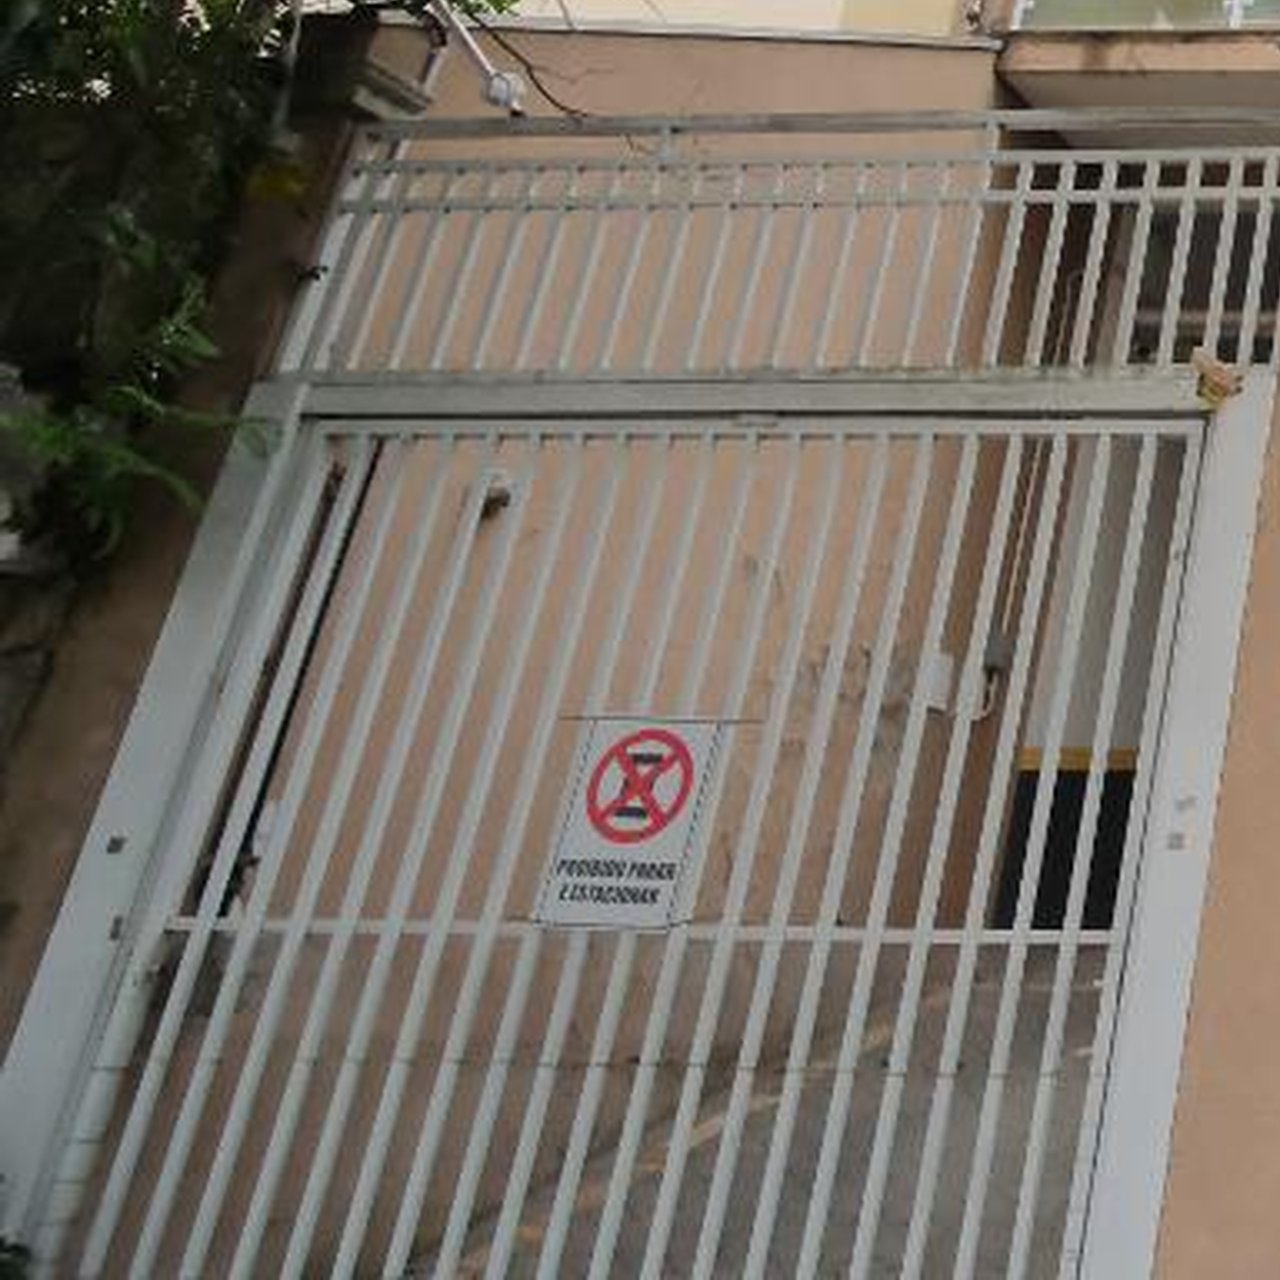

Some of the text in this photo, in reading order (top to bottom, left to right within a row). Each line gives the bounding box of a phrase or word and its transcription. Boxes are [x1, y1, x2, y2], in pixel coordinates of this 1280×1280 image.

[556, 858, 677, 881] PROIBIDO PARAR
[558, 883, 661, 904] E ESTACIONAR
